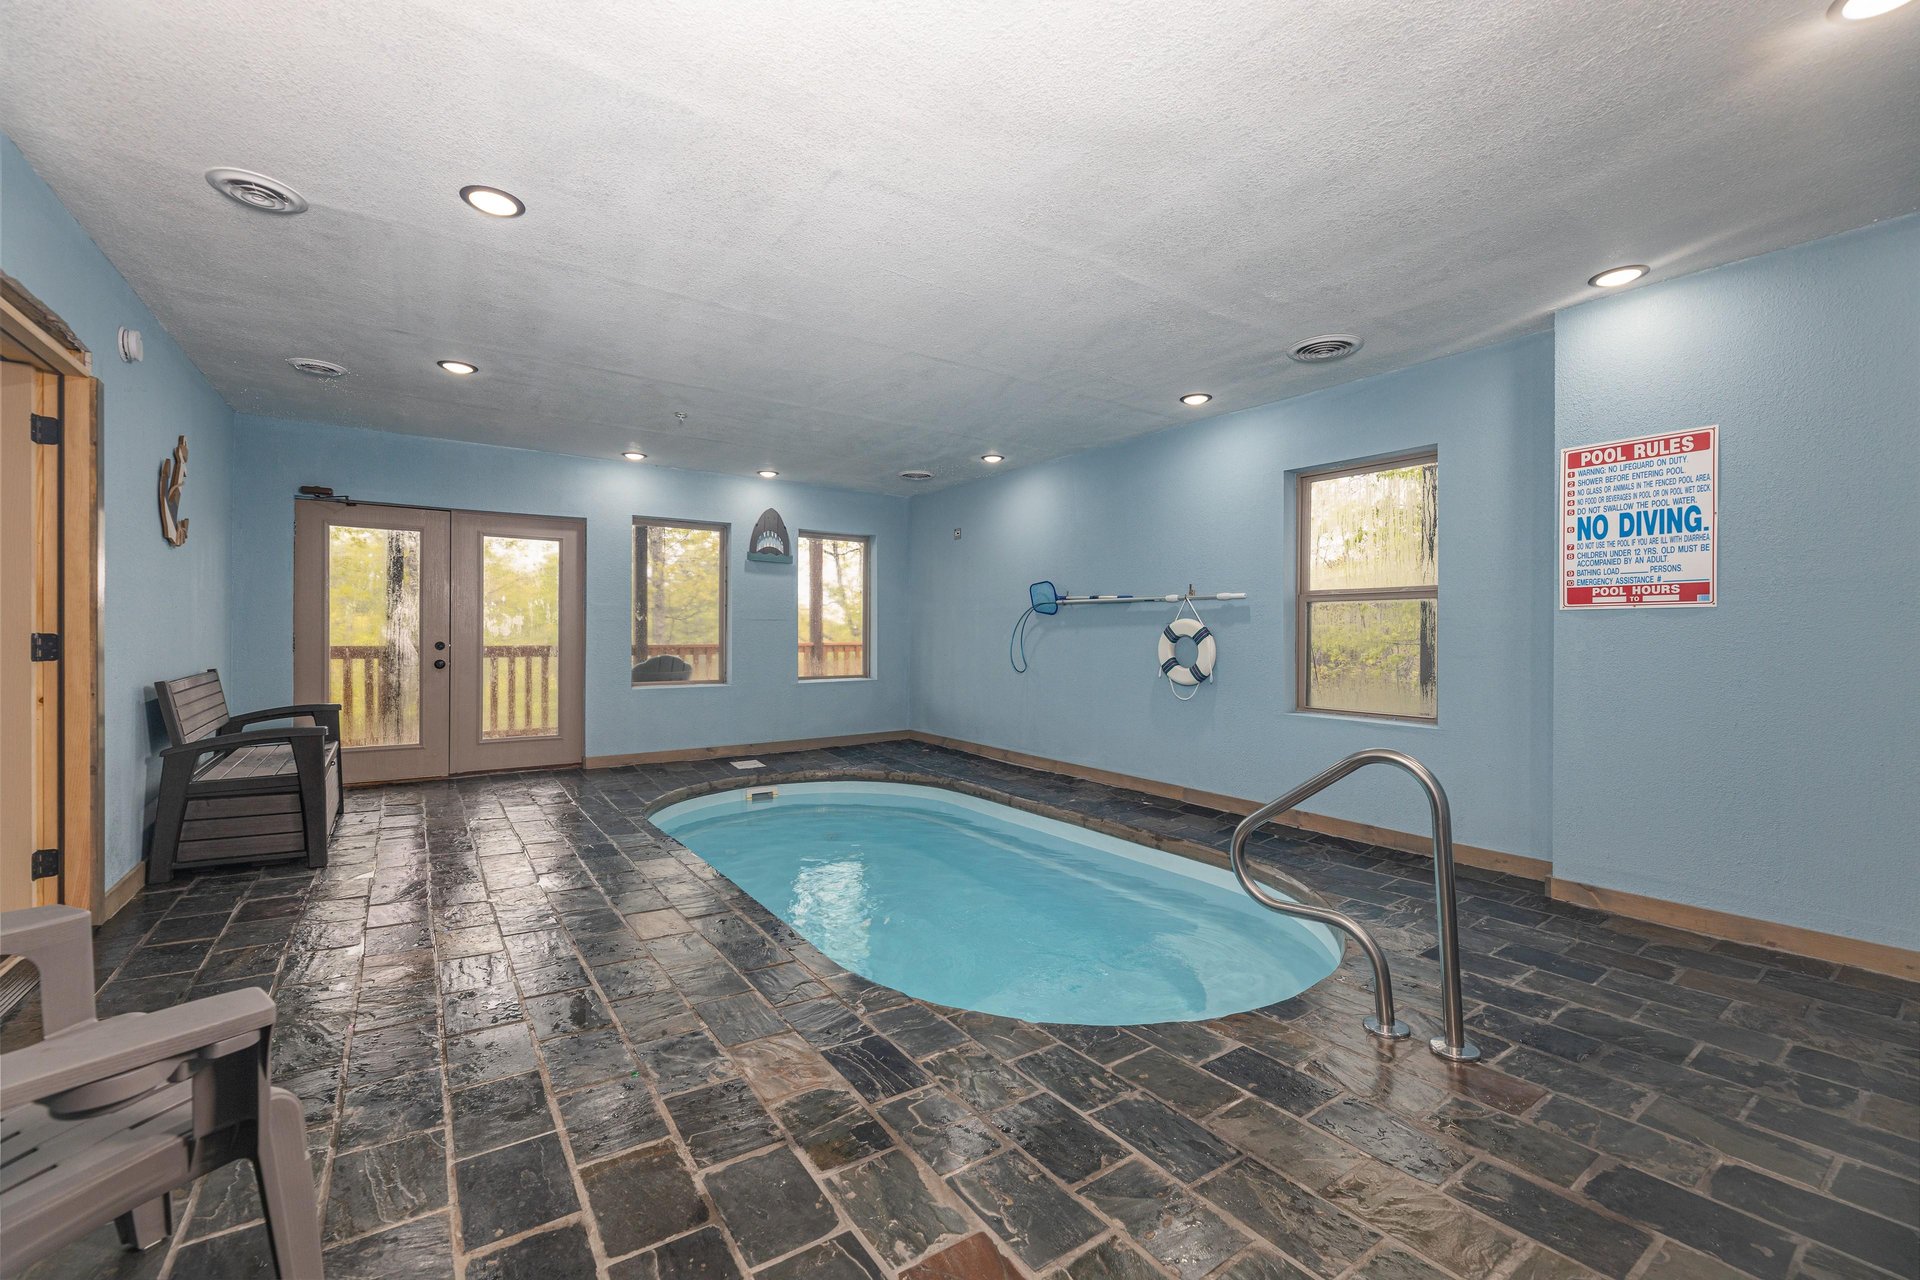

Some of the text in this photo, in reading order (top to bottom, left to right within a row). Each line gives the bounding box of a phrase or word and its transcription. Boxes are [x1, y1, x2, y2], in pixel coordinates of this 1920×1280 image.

[1581, 436, 1694, 466] POOL RULES
[1578, 467, 1606, 476] WARNING:
[1620, 460, 1654, 471] LIFEGUARD
[1578, 478, 1603, 486] SHOWER
[1605, 474, 1629, 483] BEFORE
[1632, 469, 1663, 479] ENTERING
[1586, 487, 1602, 495] GLASS
[1613, 483, 1634, 492] ANIMALS
[1655, 478, 1676, 486] FENCED
[1606, 493, 1631, 502] BEVERAGES
[1603, 503, 1634, 512] SWALLOW
[1578, 514, 1608, 541] NO
[1620, 505, 1709, 537] DIVING.
[1577, 551, 1607, 559] CHILDREN
[1577, 558, 1621, 567] ACCOMPANIED
[1616, 576, 1654, 584] ASSISTANCE
[1592, 585, 1680, 596] POOL HOURS
